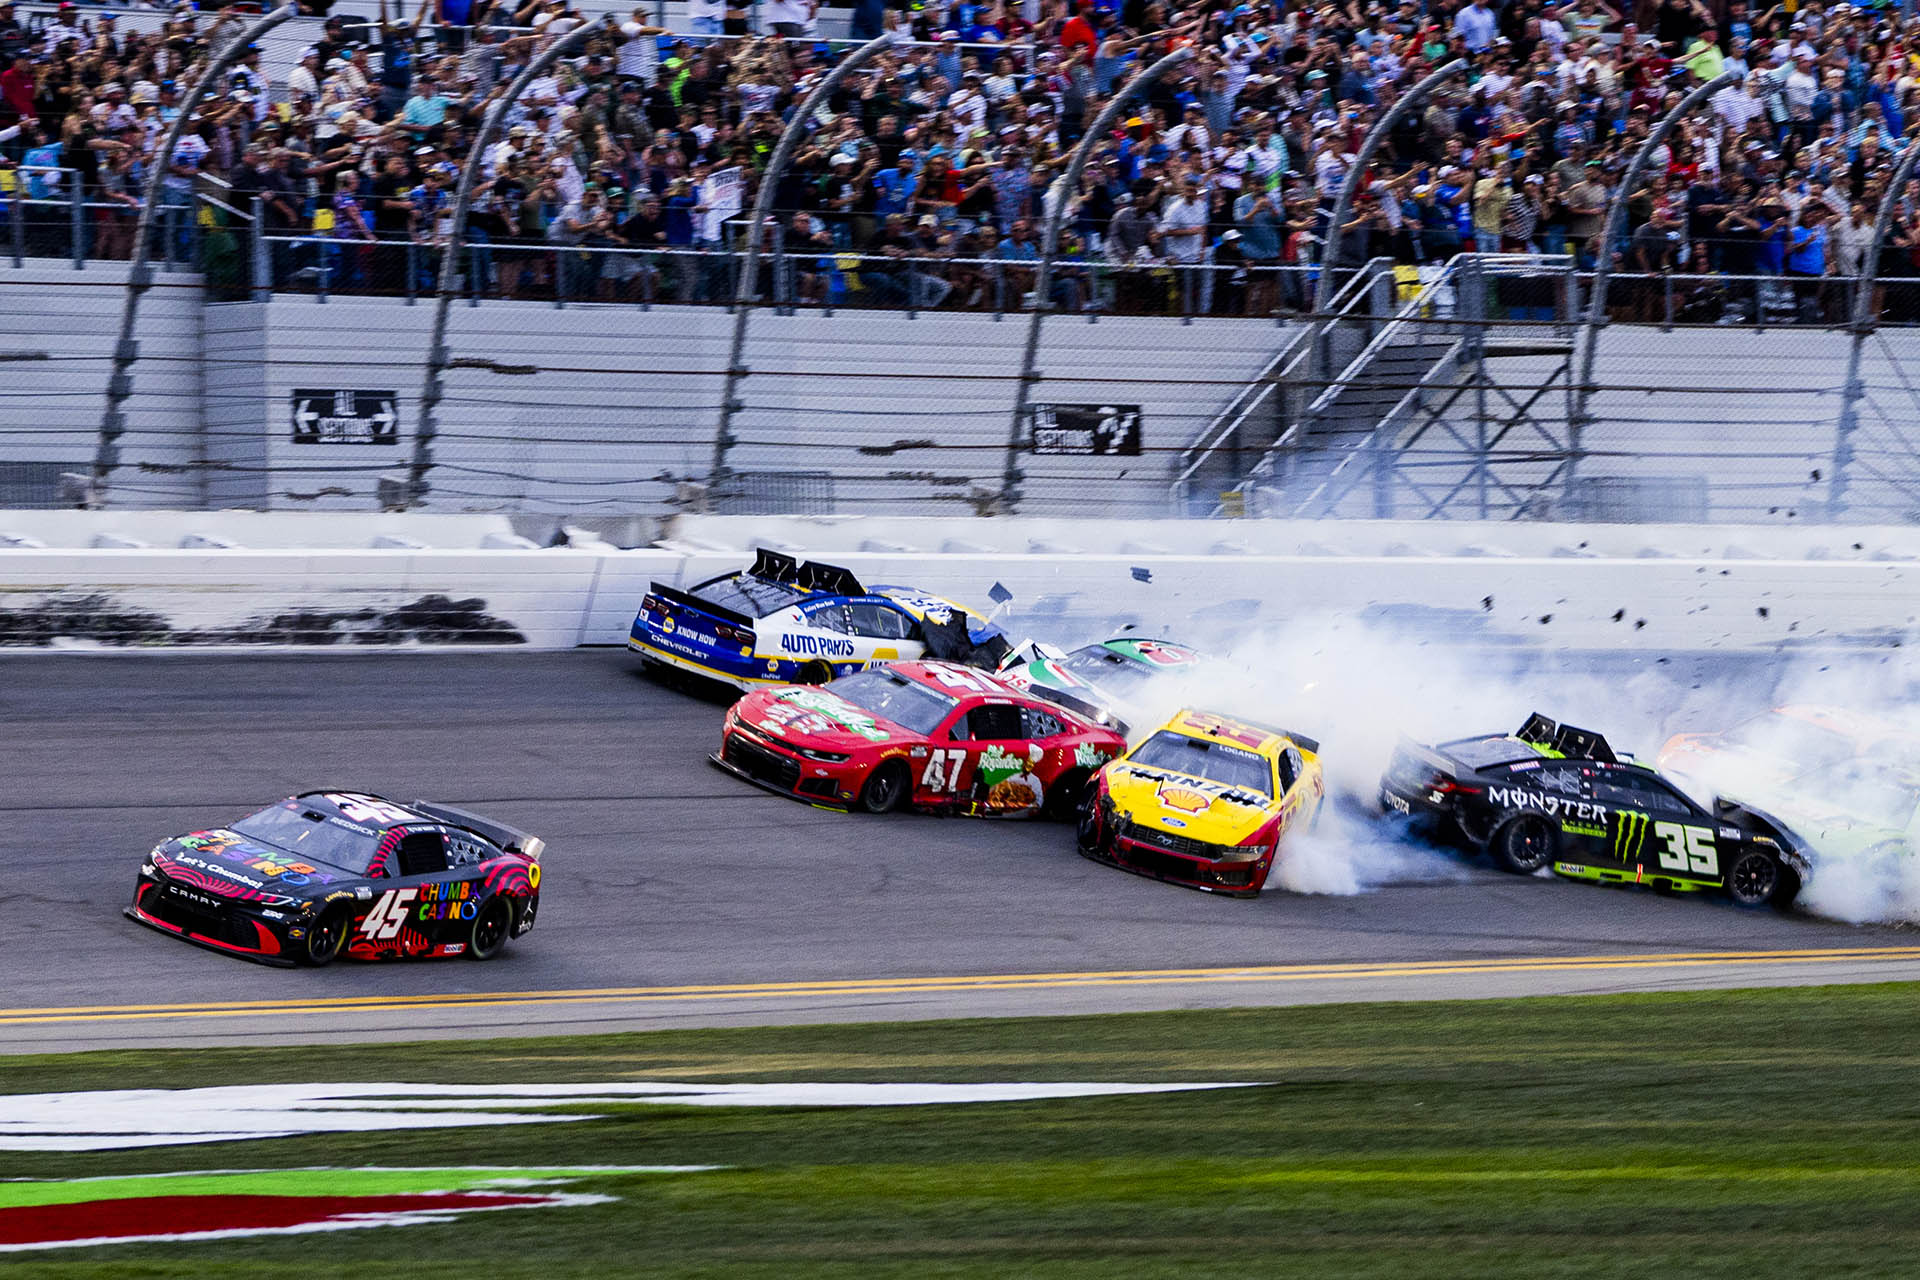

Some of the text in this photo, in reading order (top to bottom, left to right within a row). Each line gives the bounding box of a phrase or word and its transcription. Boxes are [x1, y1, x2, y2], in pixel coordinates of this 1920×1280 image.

[651, 633, 710, 660] CHEVROLET
[677, 625, 699, 641] KNOW
[698, 633, 717, 647] HOW
[781, 633, 855, 657] AUTO PARTS
[1219, 745, 1260, 761] LOGANO
[922, 749, 967, 793] 47
[323, 793, 417, 824] 45
[1384, 790, 1410, 816] TOYOTA
[330, 817, 376, 837] REDDICK
[1654, 821, 1720, 876] 35
[175, 852, 265, 889] Let's Chumba!
[169, 886, 221, 908] CAMRY
[419, 881, 481, 900] CHUMBA
[360, 888, 419, 940] 45
[418, 900, 478, 921] CASINO
